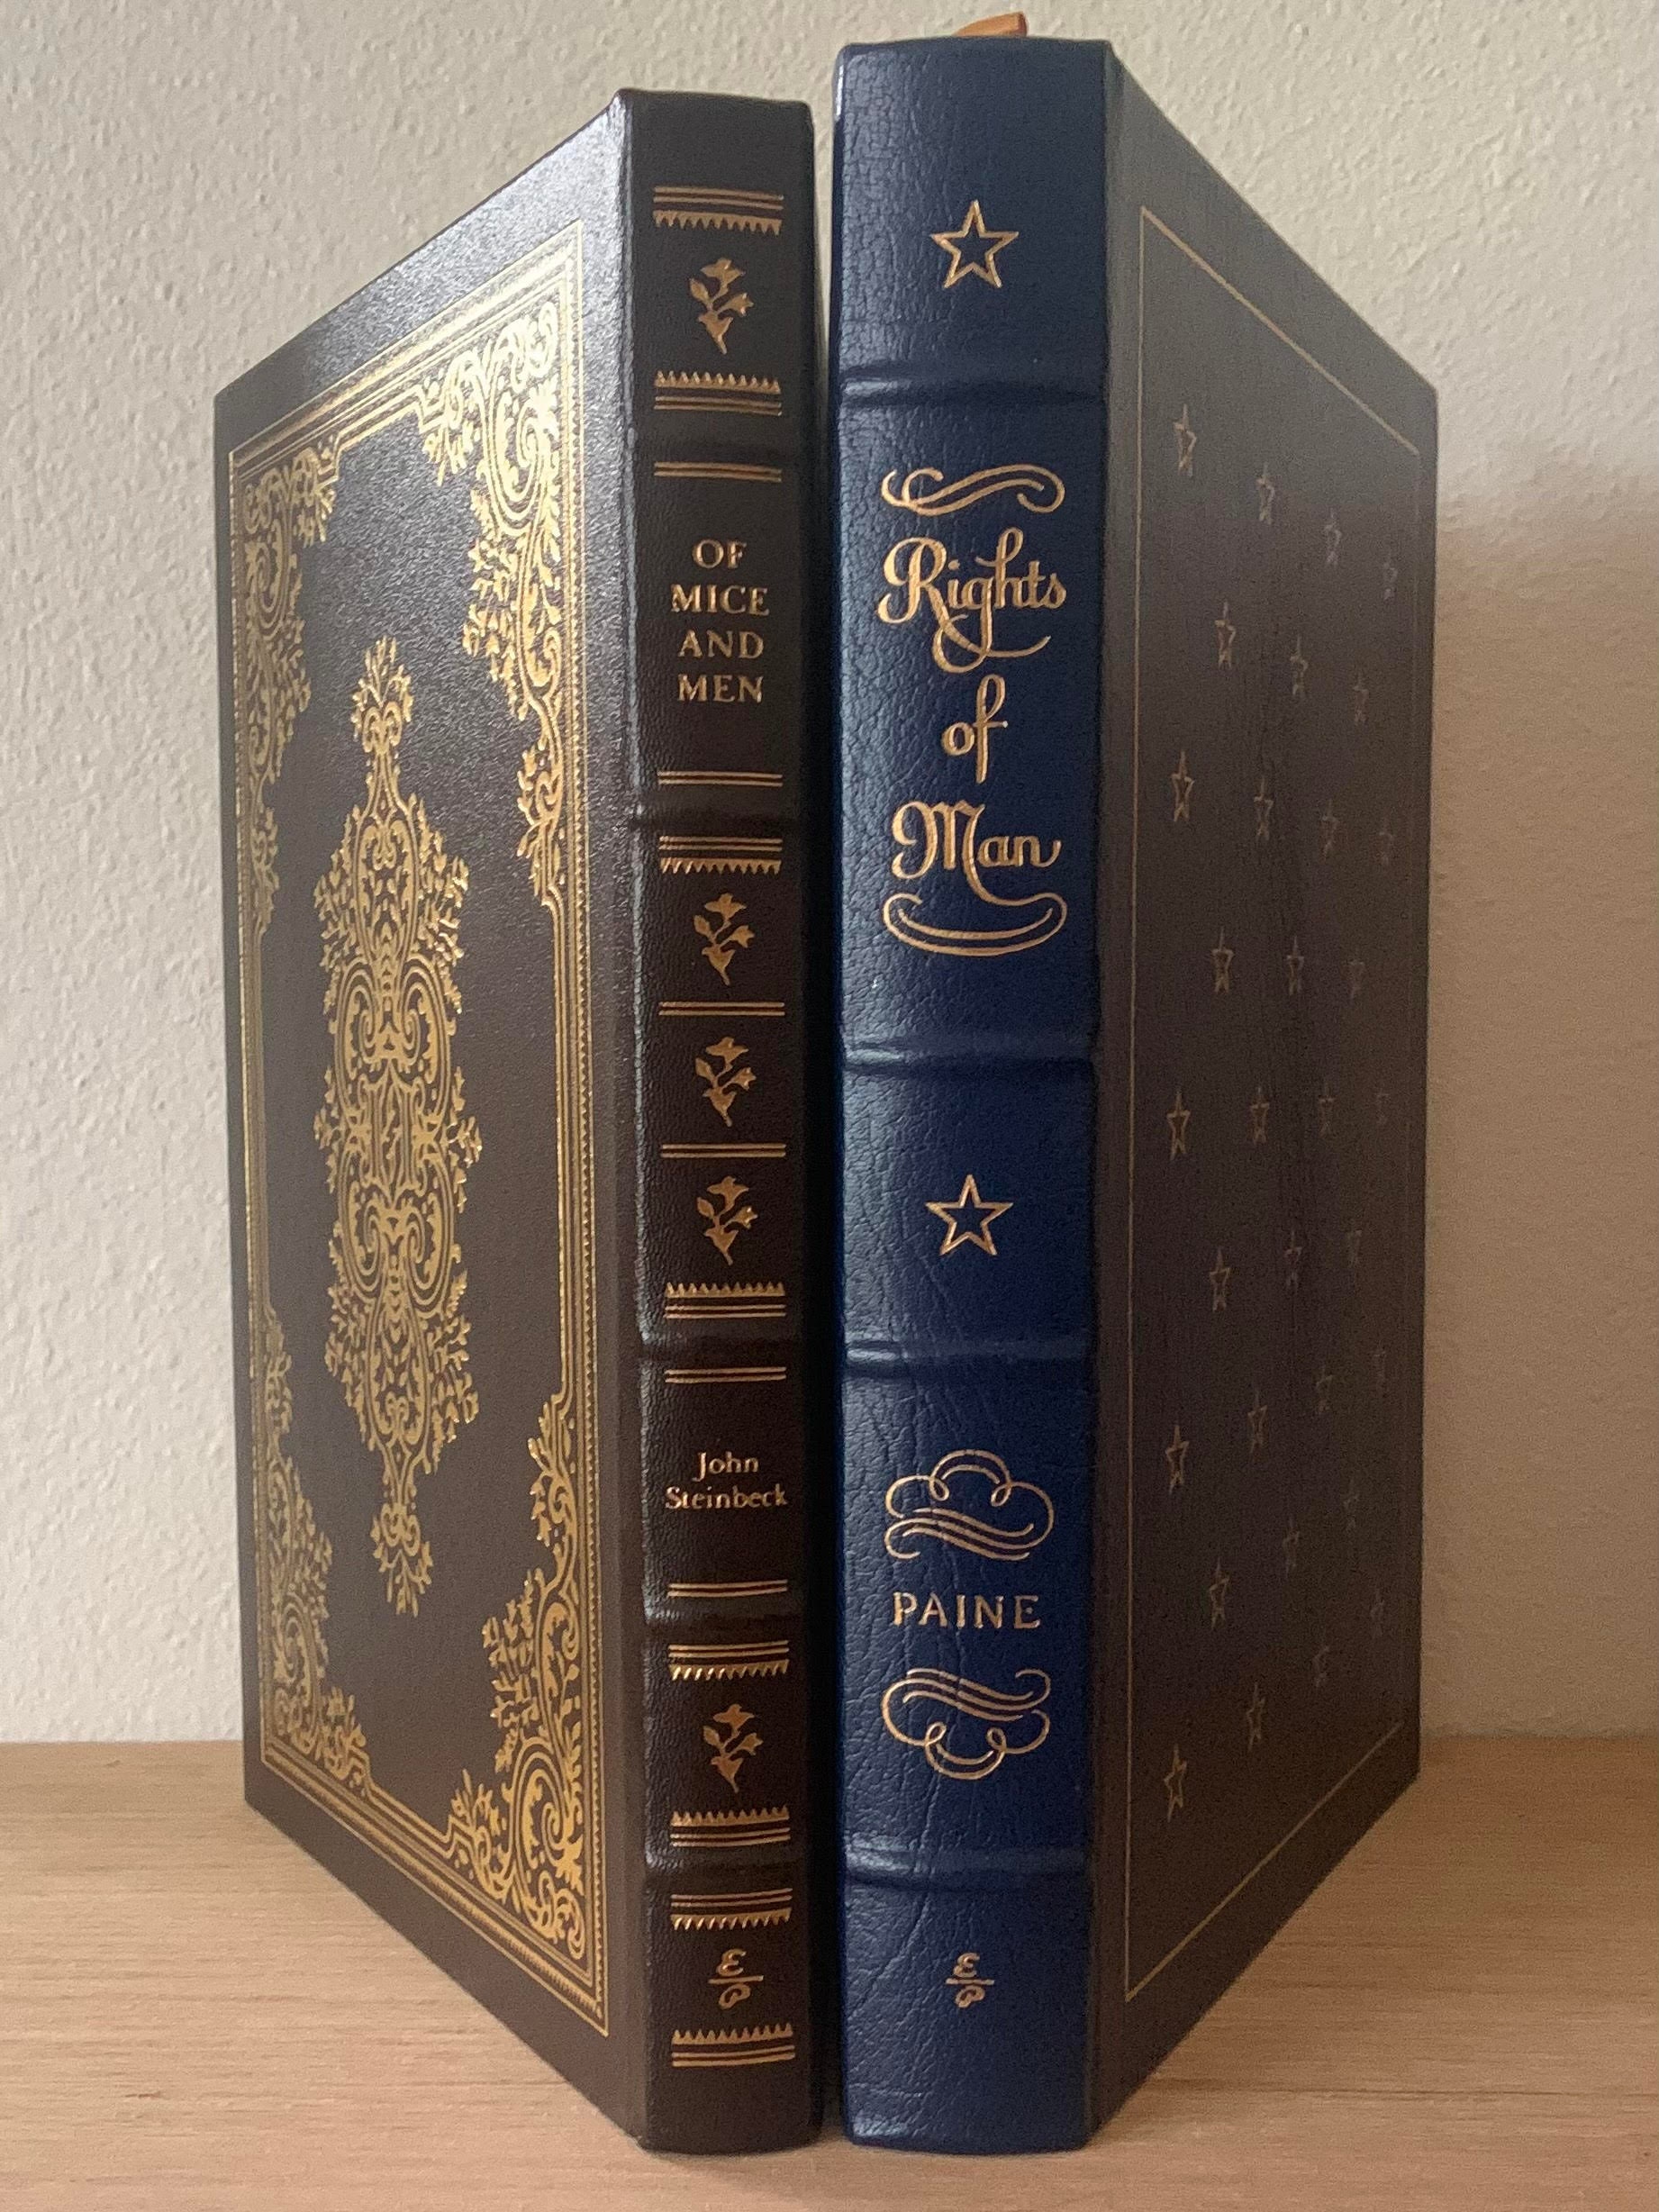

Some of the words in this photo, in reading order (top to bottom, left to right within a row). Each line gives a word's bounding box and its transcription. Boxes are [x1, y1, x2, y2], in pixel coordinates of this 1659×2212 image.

[693, 539, 747, 569] OF
[670, 585, 770, 616] MICE
[878, 527, 1066, 673] Rights
[678, 630, 765, 659] AND
[677, 674, 765, 703] MEN
[942, 675, 1008, 784] of
[892, 801, 1061, 906] Man
[692, 1451, 759, 1482] John
[665, 1483, 788, 1509] Steinbeck
[893, 1591, 1040, 1629] PAINE
